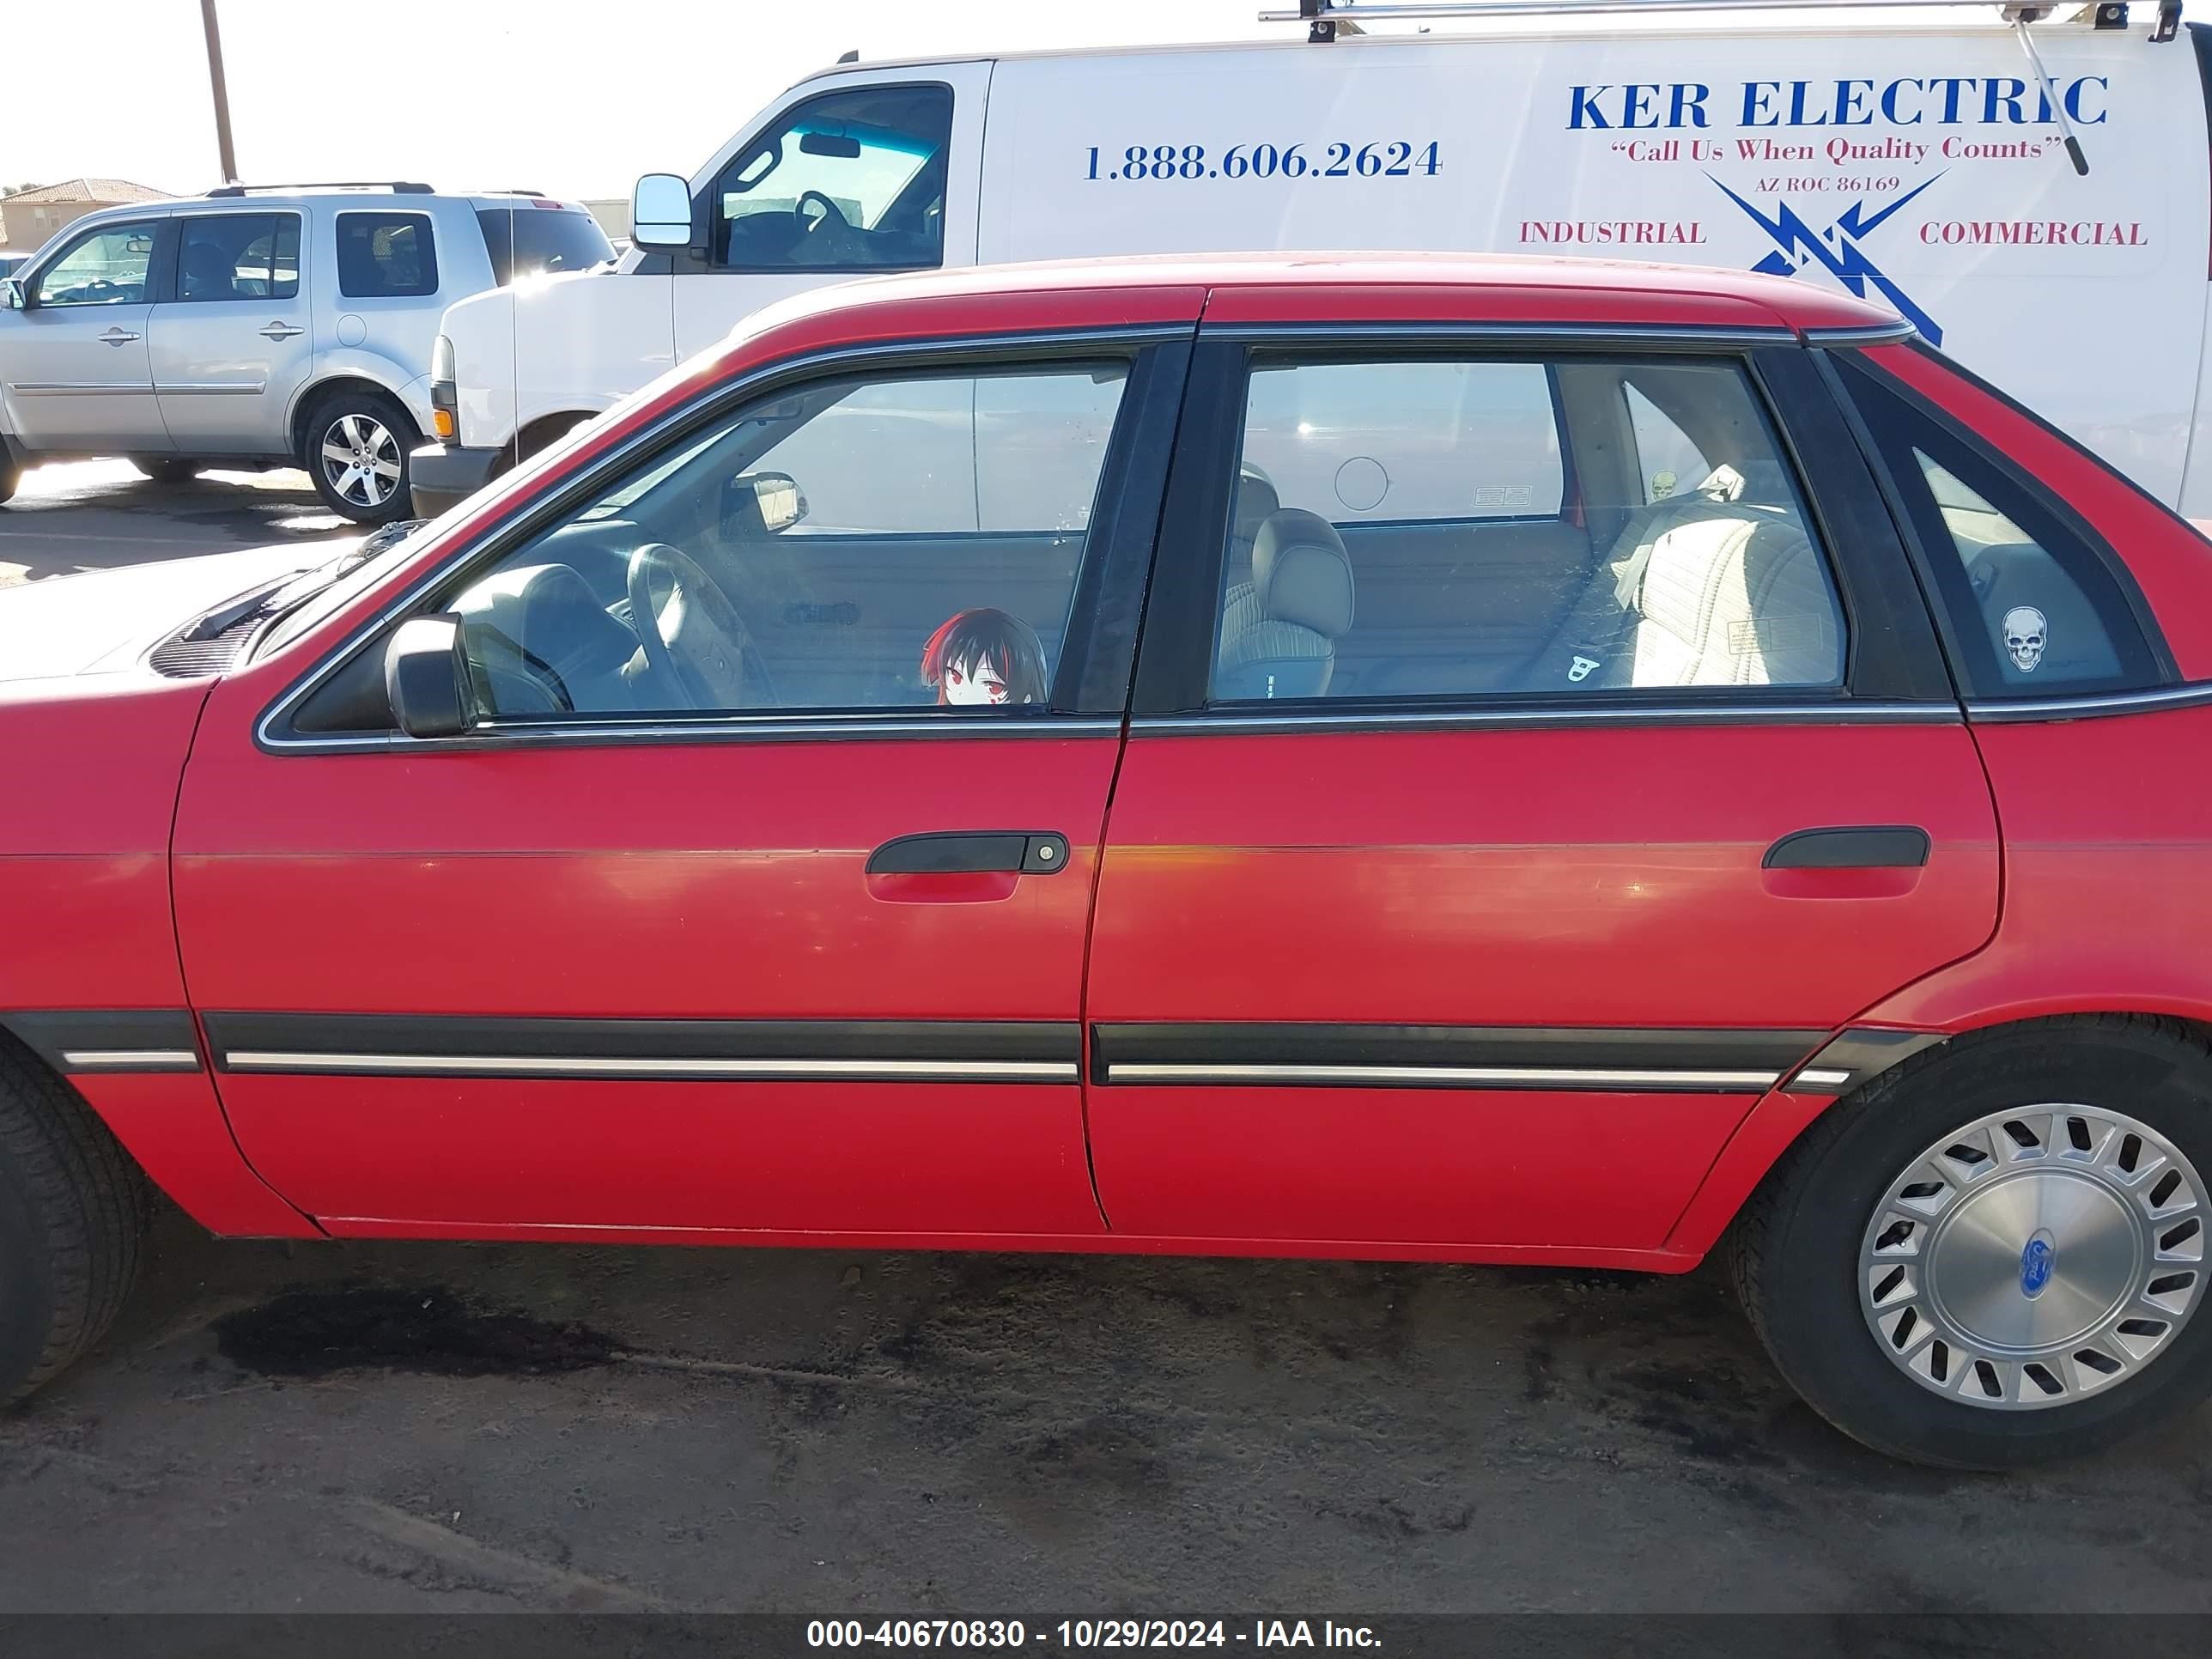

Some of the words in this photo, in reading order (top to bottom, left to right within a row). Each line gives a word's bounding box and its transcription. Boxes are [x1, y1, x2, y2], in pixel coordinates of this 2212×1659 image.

[1565, 83, 1712, 131] KER
[1735, 76, 2109, 128] ELECTRIC
[1083, 141, 1444, 180] 1.888.606.2624
[1610, 140, 1680, 162] “Call
[1692, 140, 1723, 161] Us
[1735, 138, 1814, 161] When
[1826, 137, 1929, 166] Quality
[1942, 135, 2062, 160] Counts”
[1754, 177, 1781, 192] AZ
[1786, 176, 1830, 192] ROC
[1837, 176, 1900, 191] 86169
[1518, 222, 1708, 245] INDUSTRIAL
[1919, 222, 2148, 246] COMMERCIAL
